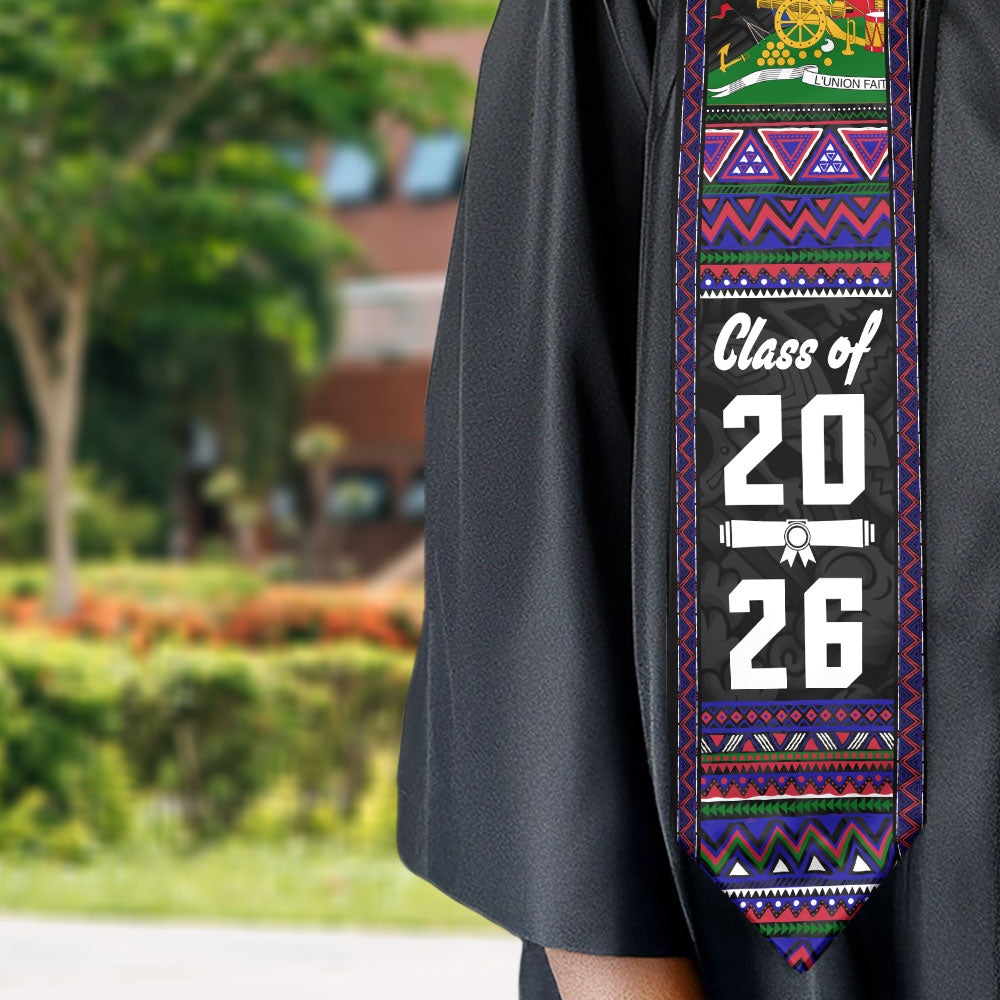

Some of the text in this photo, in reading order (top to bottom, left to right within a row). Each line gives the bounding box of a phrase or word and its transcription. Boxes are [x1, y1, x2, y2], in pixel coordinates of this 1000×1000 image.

[814, 75, 860, 89] L'UNION
[713, 308, 884, 386] Class of
[722, 393, 866, 506] 20
[728, 577, 863, 690] 26
